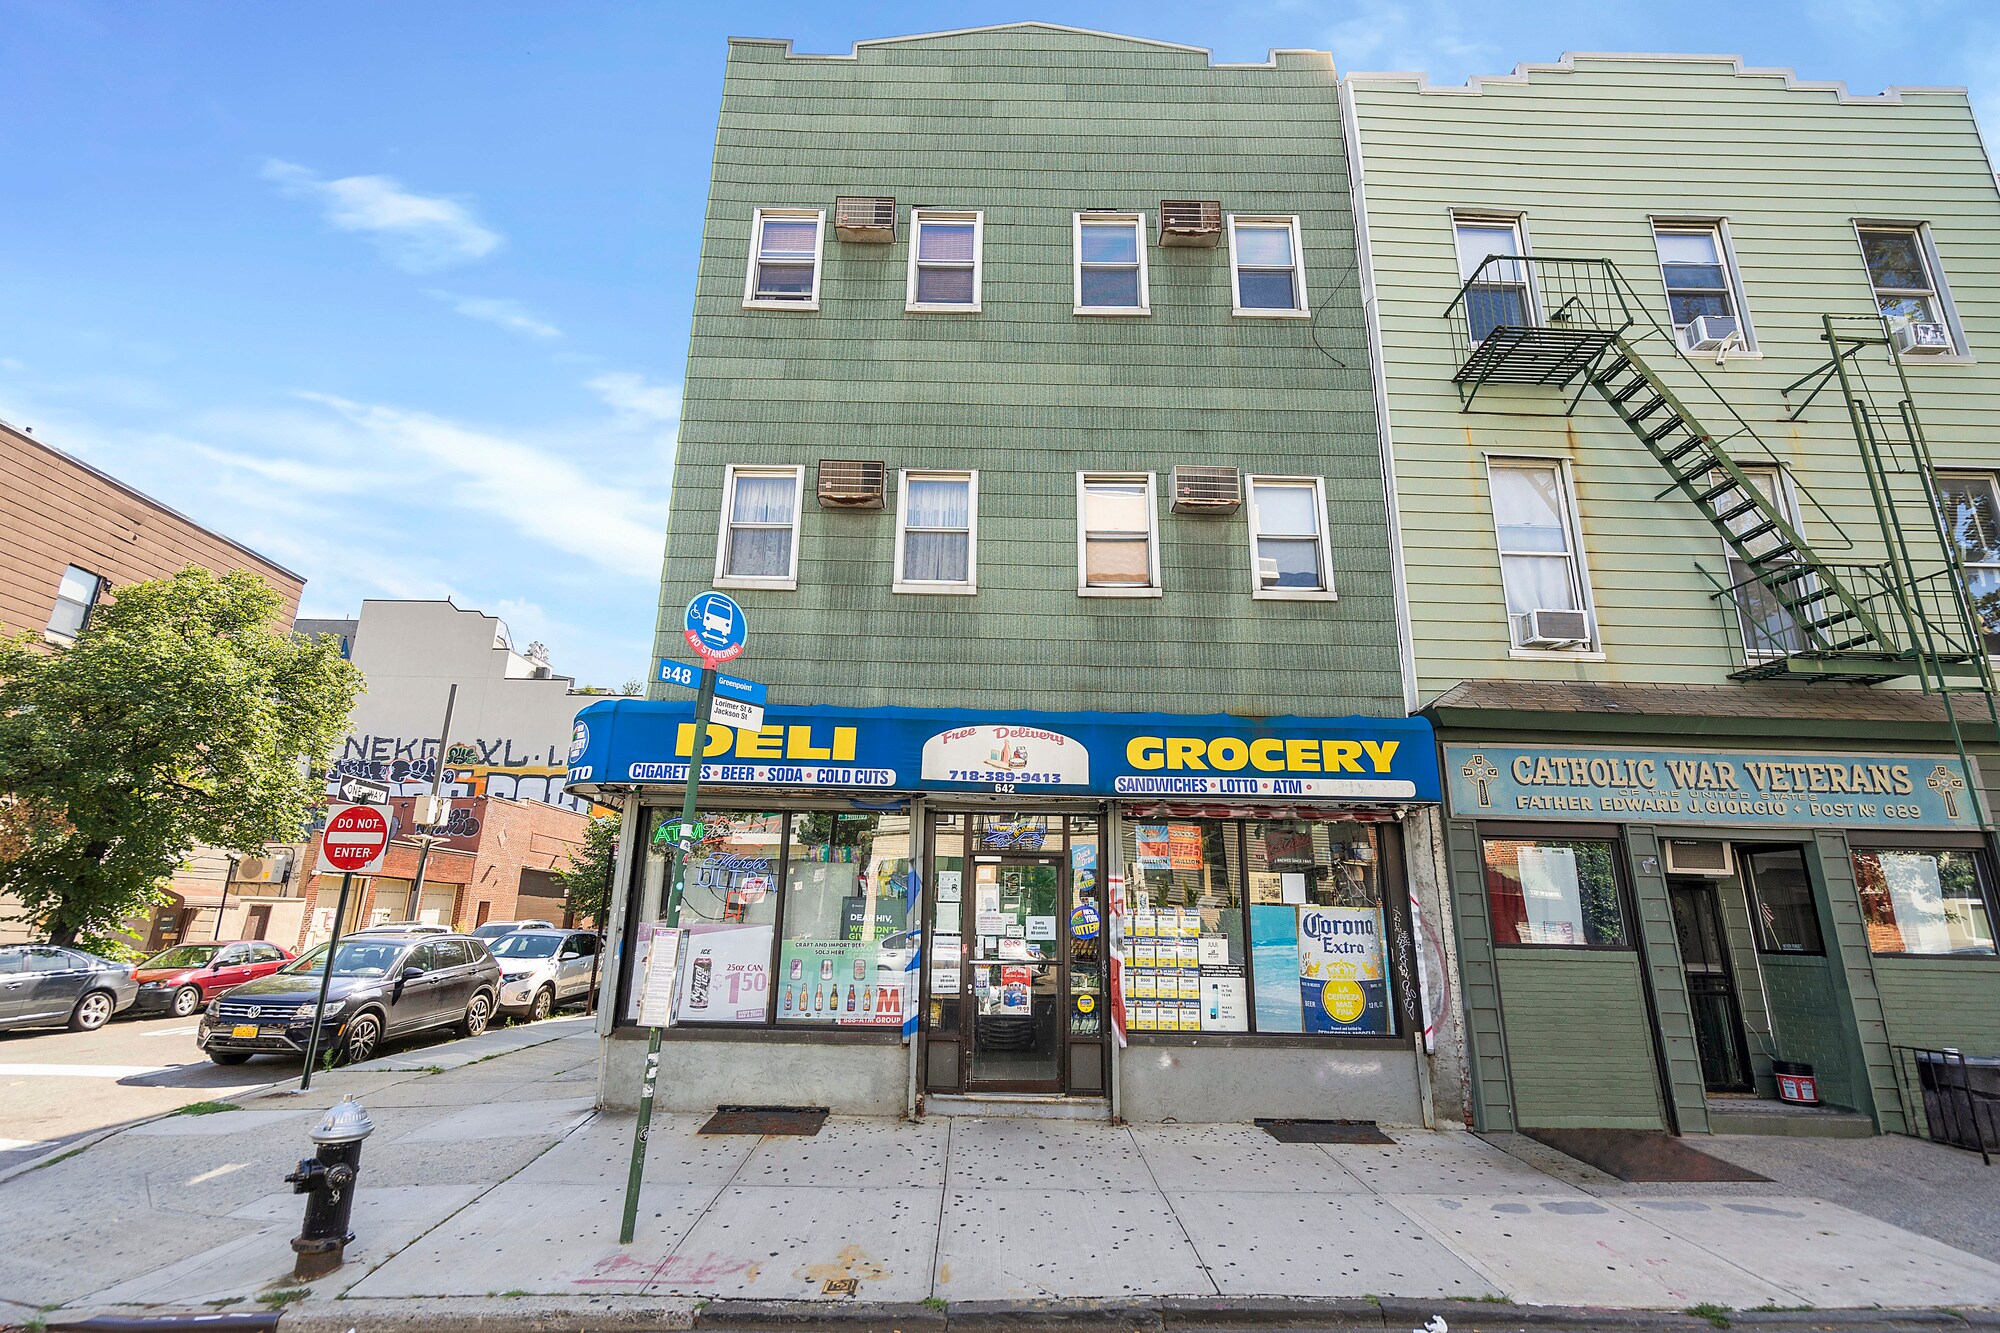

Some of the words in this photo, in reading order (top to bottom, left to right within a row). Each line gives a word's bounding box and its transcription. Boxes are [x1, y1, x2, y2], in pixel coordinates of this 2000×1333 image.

[689, 634, 701, 647] NO
[701, 645, 739, 659] STANDING
[662, 666, 692, 685] B48
[718, 677, 752, 692] Greenpoint
[714, 698, 739, 711] Lorimer
[740, 704, 748, 713] St
[747, 706, 753, 714] &
[713, 708, 740, 719] Jackson
[741, 711, 748, 721] St
[675, 723, 857, 761] DELI
[941, 727, 977, 745] Free
[992, 726, 1065, 746] Delivery
[1126, 736, 1400, 773] GROCERY
[565, 765, 593, 781] TTO
[721, 766, 755, 781] BEER
[767, 767, 803, 782] SODA
[816, 768, 850, 784] COLD
[855, 769, 889, 785] CUTS
[949, 770, 1061, 783] 718-389-9413
[1512, 755, 1657, 790] CATHOLIC
[1665, 760, 1740, 792] WAR
[1743, 762, 1914, 796] VETERANS
[347, 784, 363, 798] ONE
[368, 787, 384, 801] WAY
[995, 783, 1015, 794] 642
[1117, 778, 1208, 793] SANDWICHES
[1219, 779, 1258, 794] LOTTO
[1272, 780, 1302, 794] ATM
[1618, 789, 1641, 798] OF
[1650, 790, 1680, 798] THE
[1689, 791, 1750, 800] UNITED
[1760, 792, 1818, 801] STATES
[1515, 795, 1594, 811] FATHER
[1600, 797, 1682, 813] EDWARD
[1810, 802, 1854, 817] POST
[1883, 804, 1921, 819] 689
[337, 818, 354, 829] DO
[356, 818, 380, 830] NOT
[334, 847, 370, 859] ENTER
[1076, 848, 1091, 860] Quick
[1081, 856, 1095, 866] Draw
[876, 915, 893, 924] HIV,
[1083, 909, 1094, 917] NEW
[1085, 914, 1099, 923] YORK
[1303, 912, 1374, 941] Corona
[1322, 936, 1365, 954] Extra
[747, 964, 763, 972] CAN
[1304, 1000, 1316, 1008] BEER
[1335, 1001, 1352, 1009] MAS
[1335, 1008, 1354, 1016] FINA
